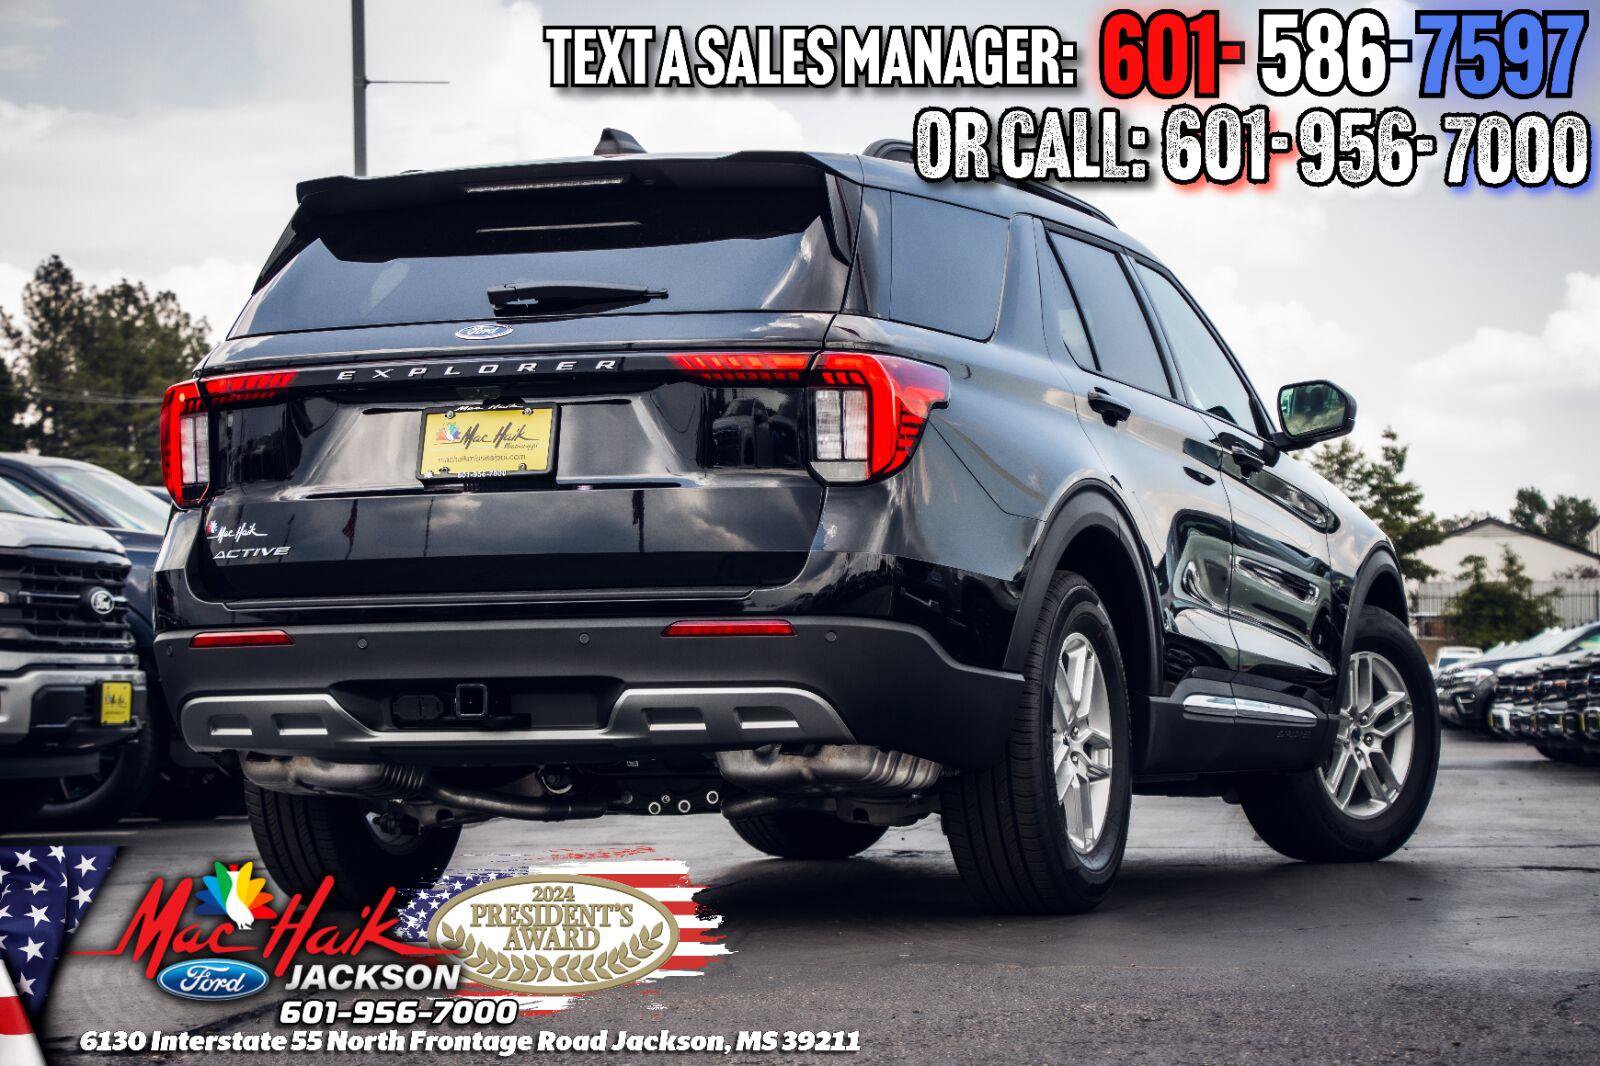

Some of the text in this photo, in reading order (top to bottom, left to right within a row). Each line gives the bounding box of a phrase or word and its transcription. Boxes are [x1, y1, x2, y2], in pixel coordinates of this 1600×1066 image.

[336, 360, 616, 381] EXPLORER
[446, 422, 540, 450] Mac Haik
[207, 522, 268, 543] Mac Haik
[213, 546, 291, 560] ACTIVE
